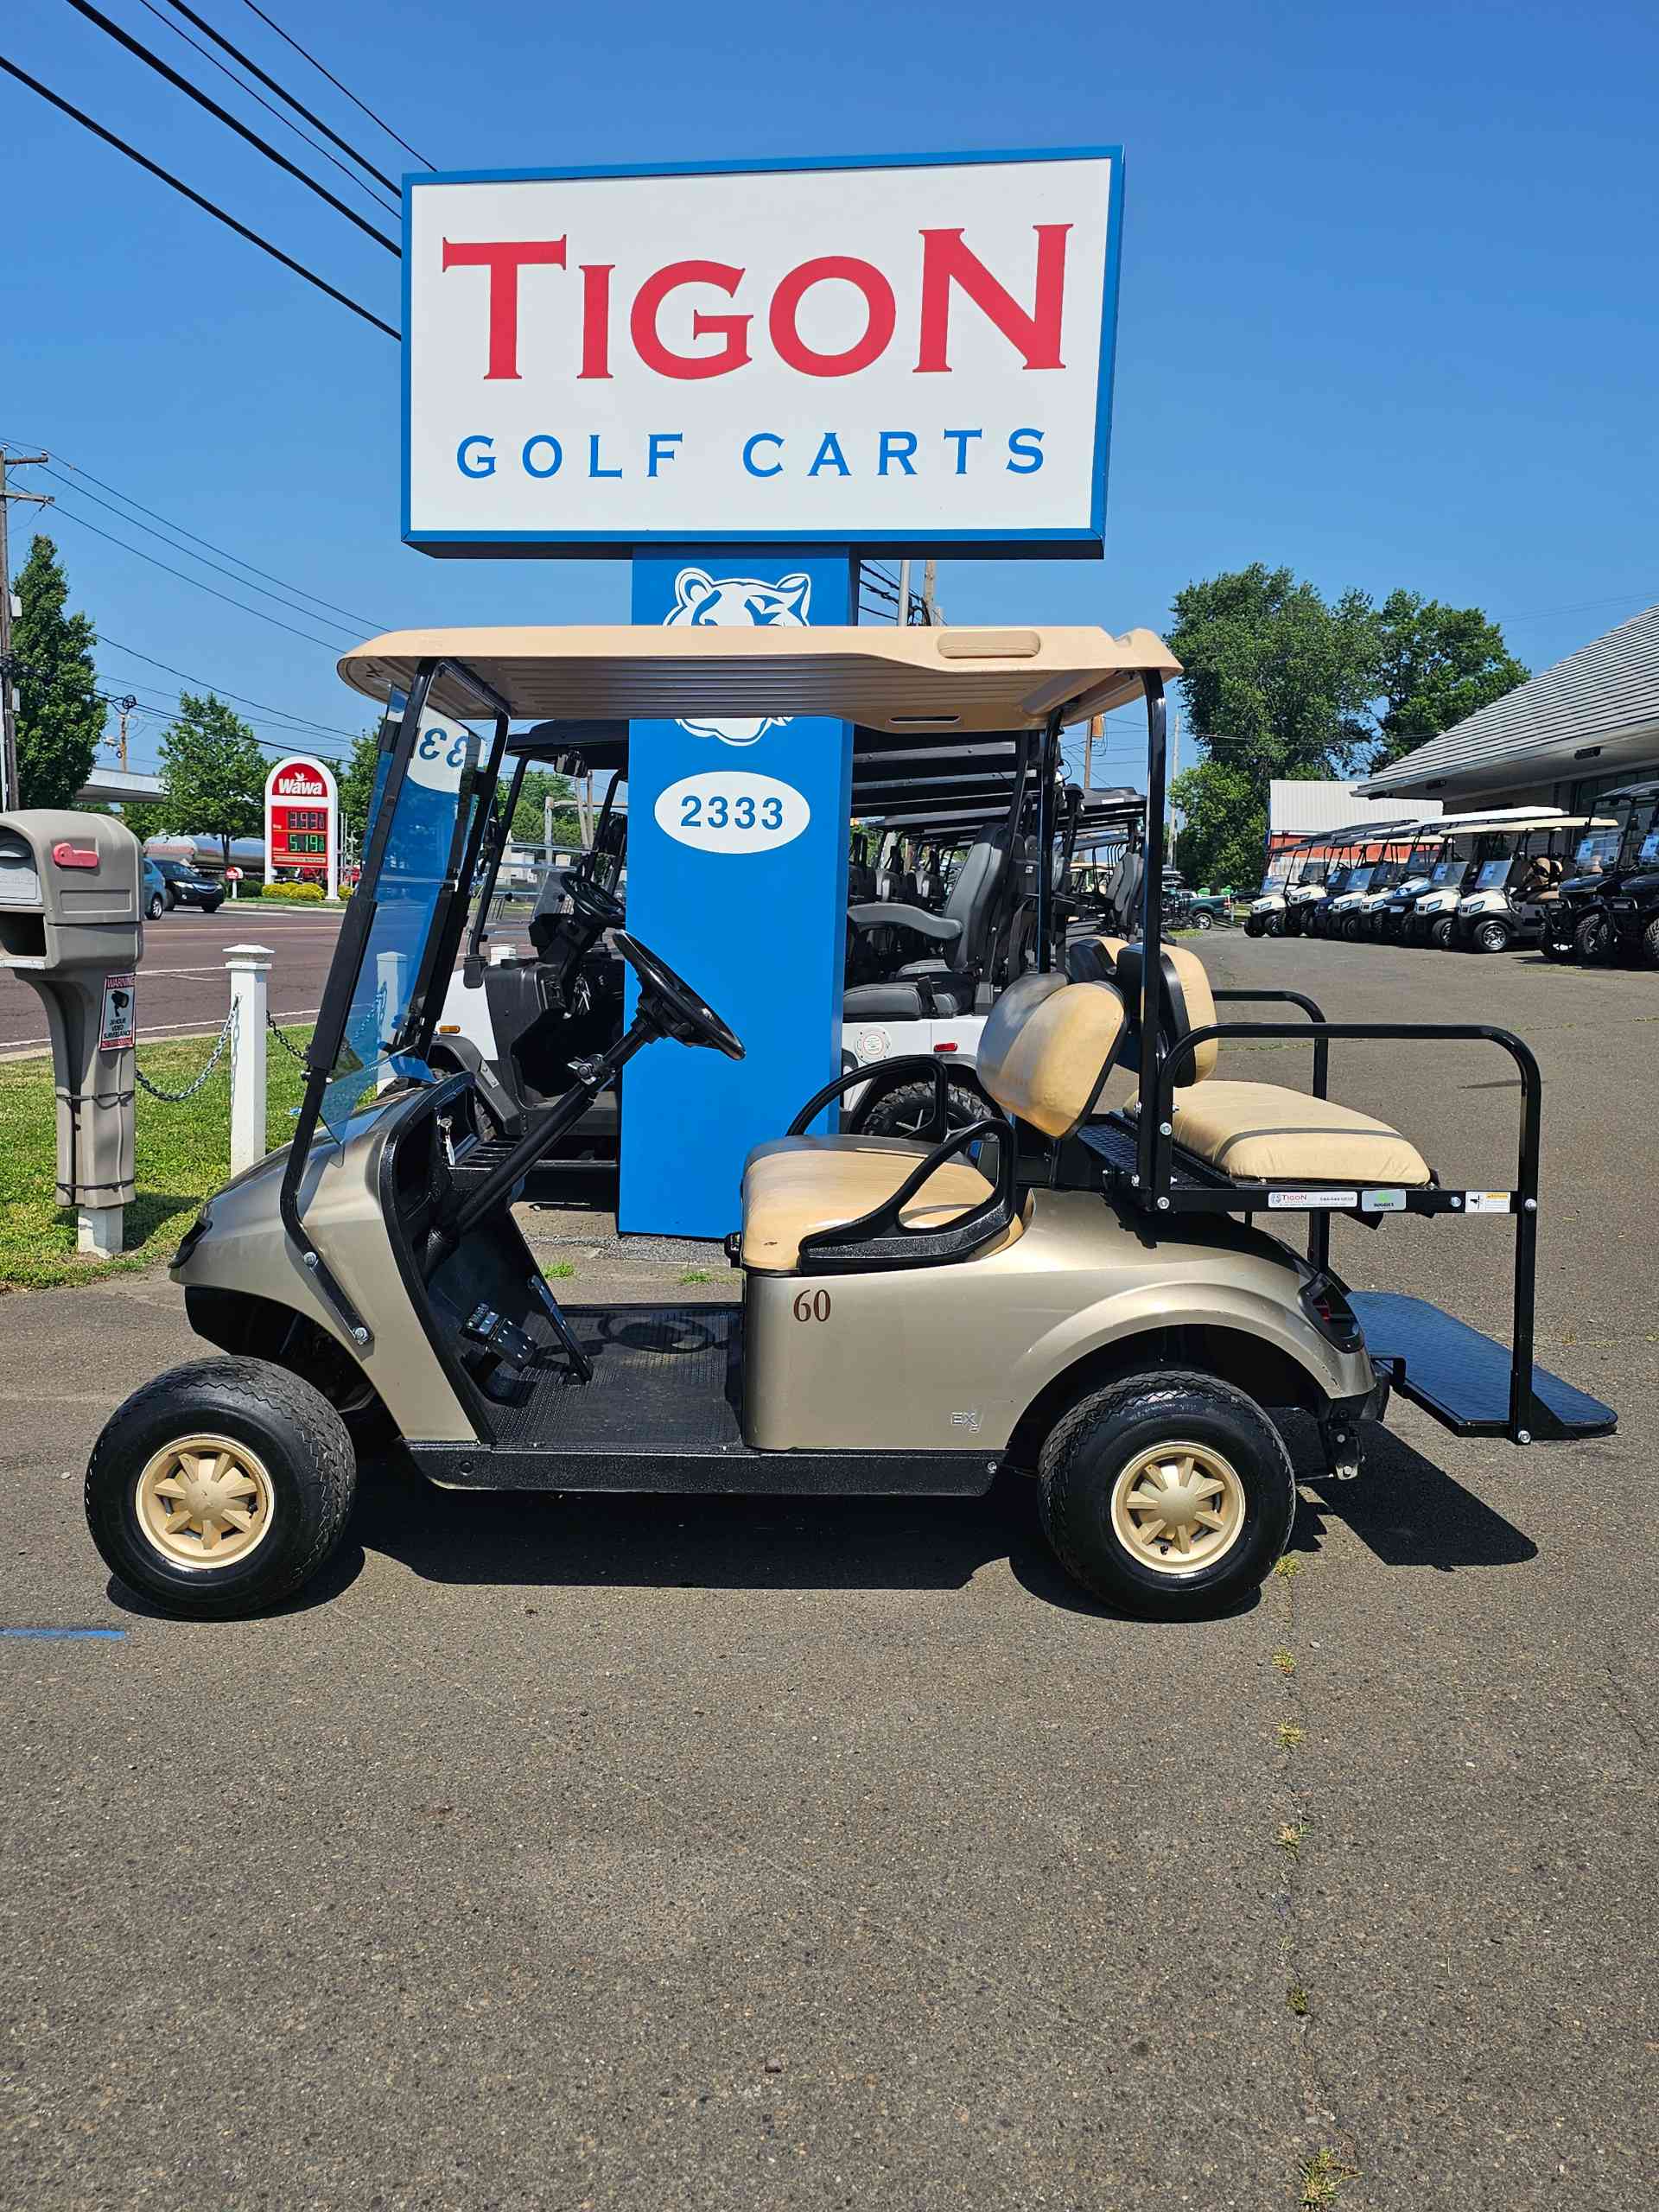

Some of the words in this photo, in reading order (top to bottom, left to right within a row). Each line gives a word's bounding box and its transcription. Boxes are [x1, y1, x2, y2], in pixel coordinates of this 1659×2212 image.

[442, 224, 1073, 379] TIGON
[457, 432, 683, 479] GOLF
[742, 428, 1045, 478] CARTS
[278, 779, 323, 795] Wawa
[680, 795, 783, 830] 2333
[793, 1289, 831, 1322] 60
